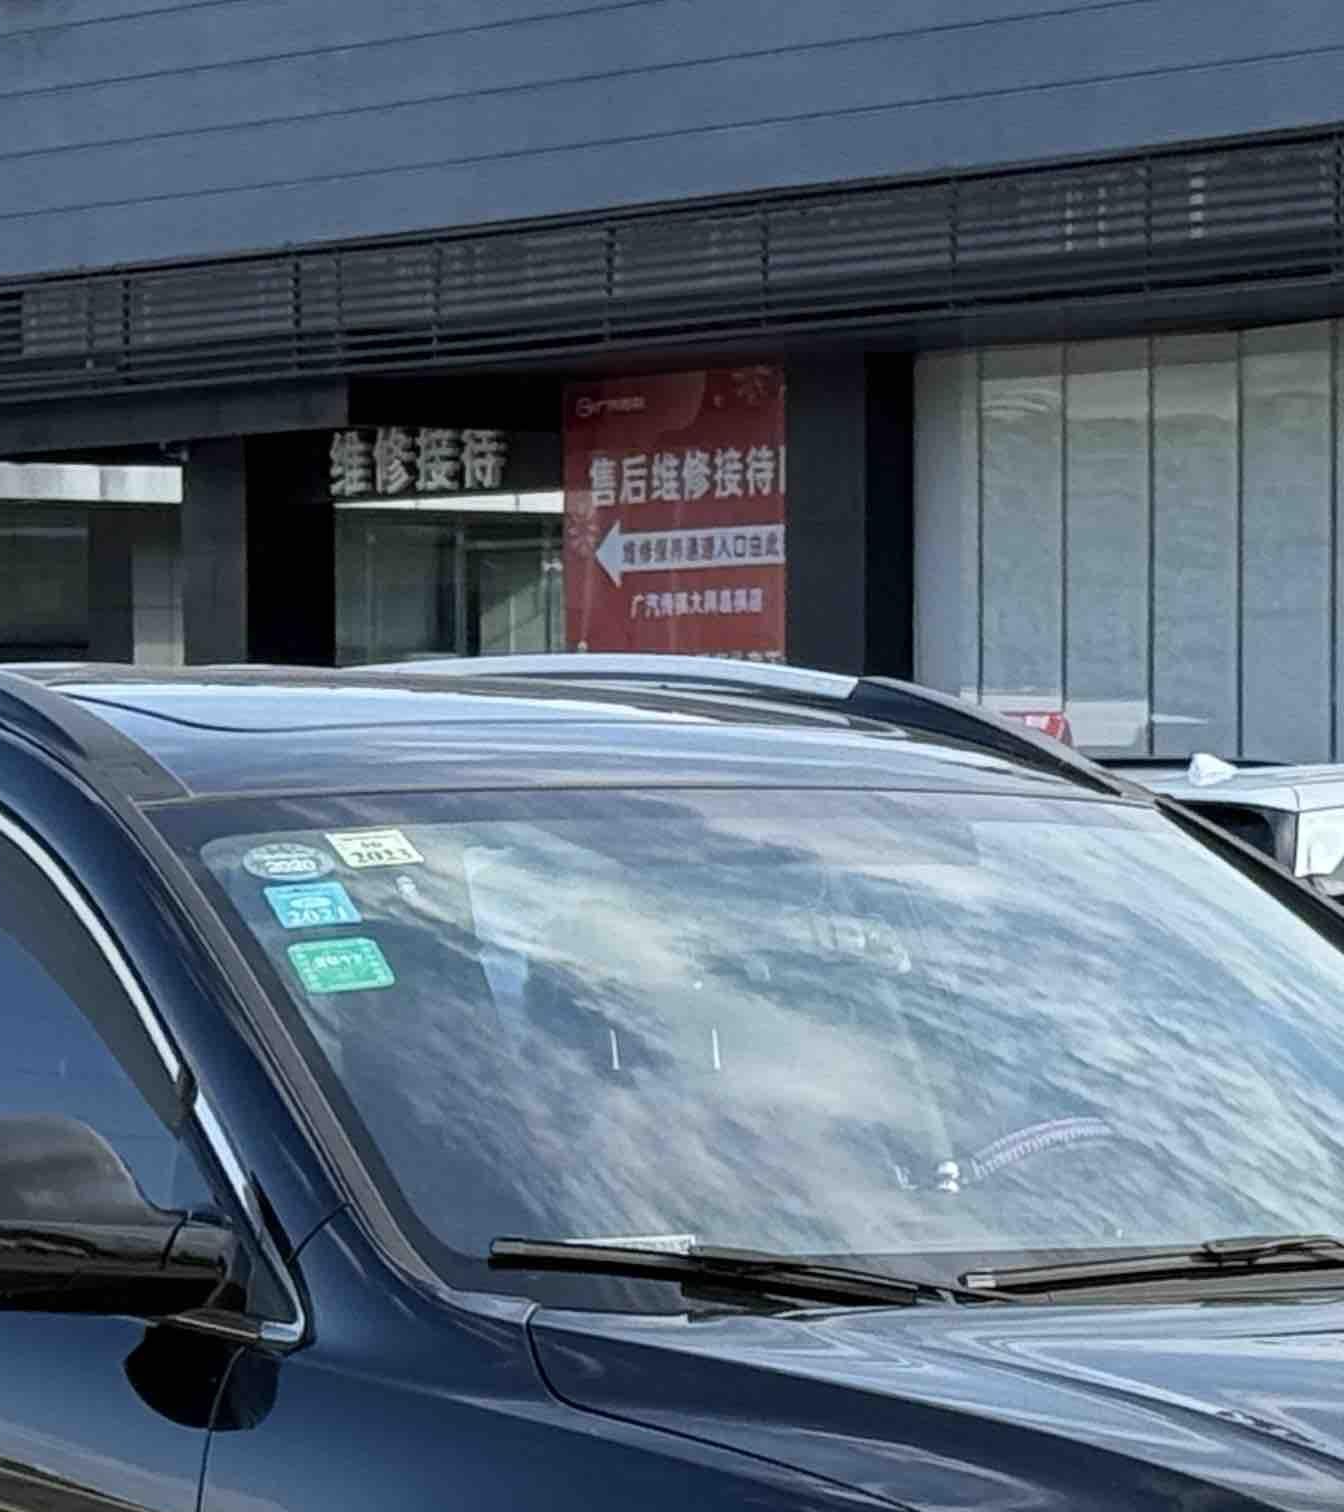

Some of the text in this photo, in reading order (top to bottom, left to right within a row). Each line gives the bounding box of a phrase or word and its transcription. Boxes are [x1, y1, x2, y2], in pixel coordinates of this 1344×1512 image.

[330, 427, 507, 496] 维修接待
[590, 444, 786, 507] 售后维修接待
